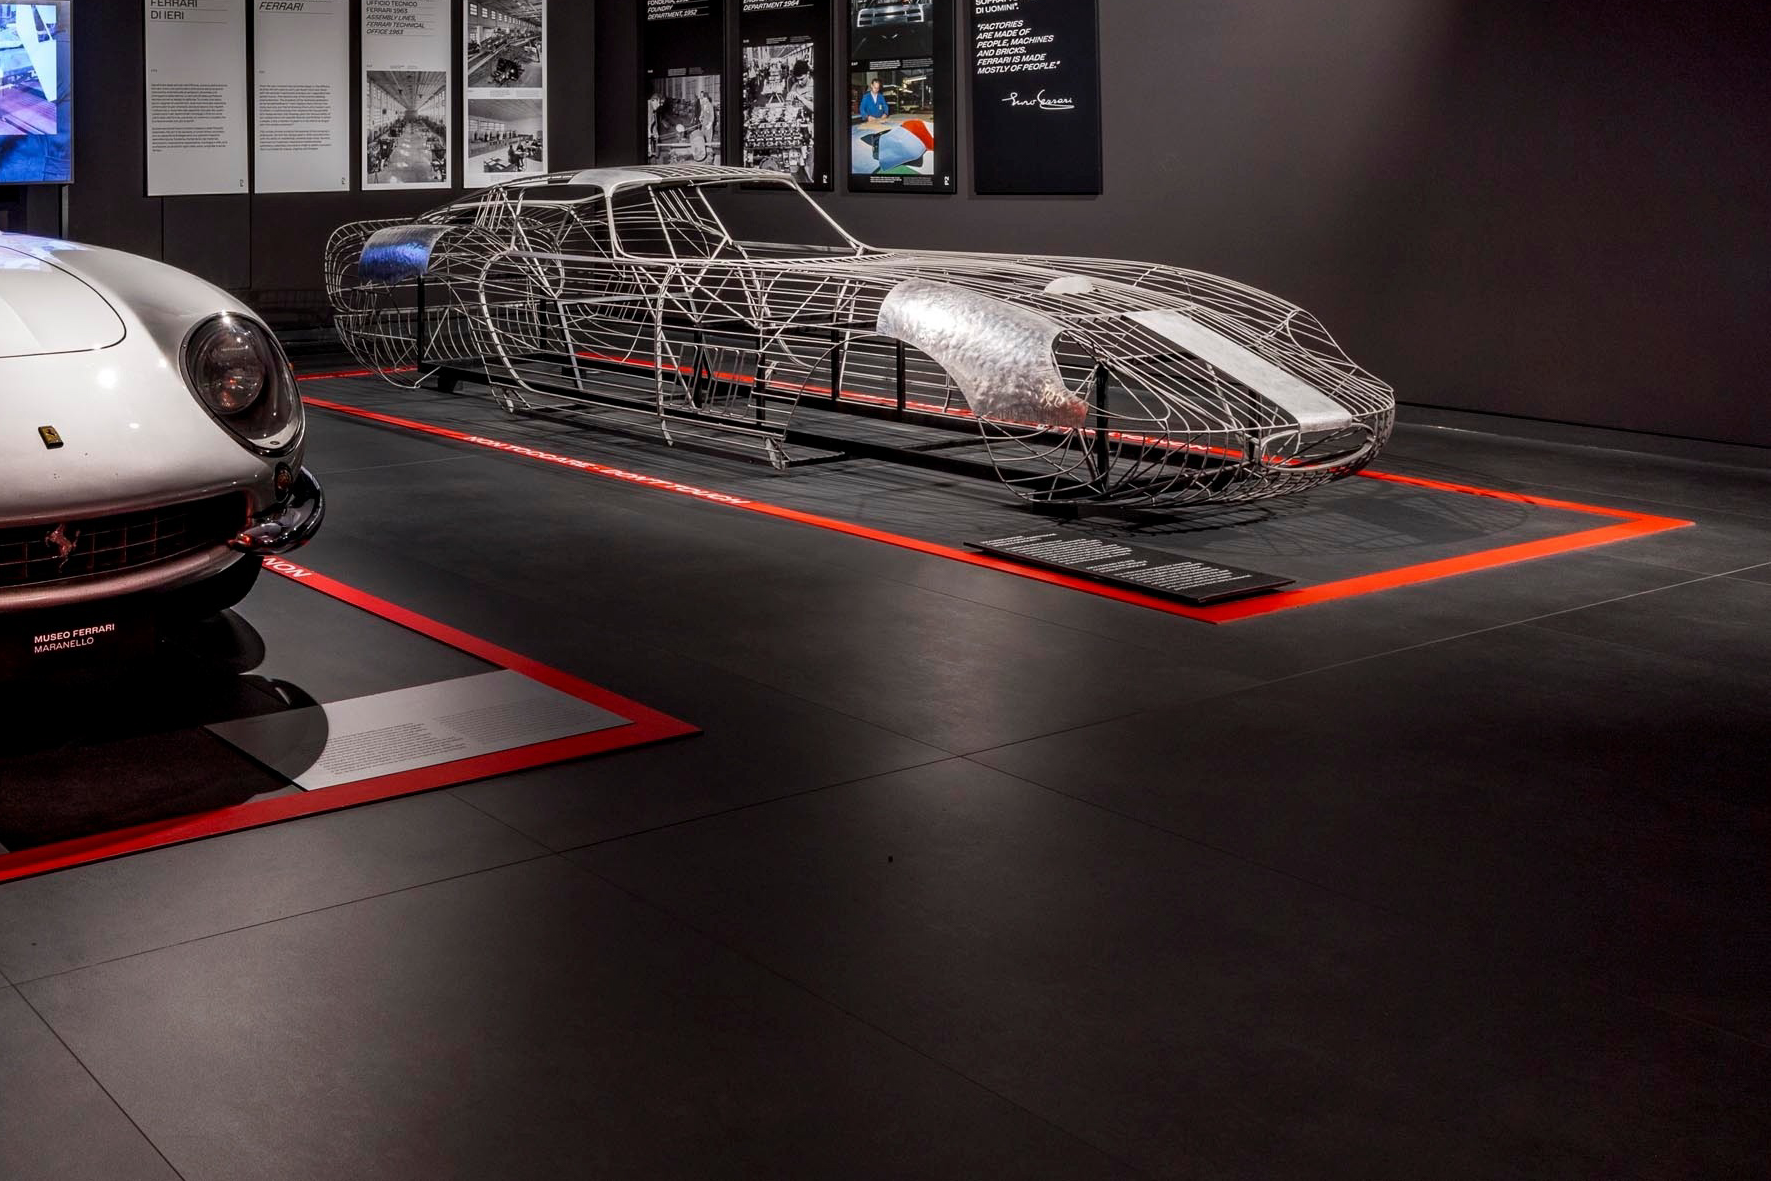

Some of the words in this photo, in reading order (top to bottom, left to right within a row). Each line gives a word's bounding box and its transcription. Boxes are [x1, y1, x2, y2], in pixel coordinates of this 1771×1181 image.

[259, 1, 304, 11] FERRARI
[743, 1, 783, 11] DEPARTMENT
[151, 10, 161, 19] DI
[164, 11, 184, 19] IERI
[976, 32, 993, 40] ARE
[994, 30, 1018, 38] MADE
[977, 39, 1009, 48] PEOPLE,
[1010, 35, 1054, 45] MACHINES
[977, 49, 994, 57] AND
[996, 47, 1026, 56] BRICKS.
[977, 57, 1011, 66] FERRARI
[1021, 54, 1046, 62] MADE
[977, 65, 1010, 74] MOSTLY
[1011, 64, 1022, 72] OF
[464, 436, 505, 449] NON
[504, 445, 595, 468] TOCCARE
[668, 483, 751, 504] TOUCH
[263, 557, 313, 577] NON
[34, 631, 70, 643] MUSEO
[72, 623, 115, 638] FERRARI
[34, 637, 94, 653] MARANELLO
